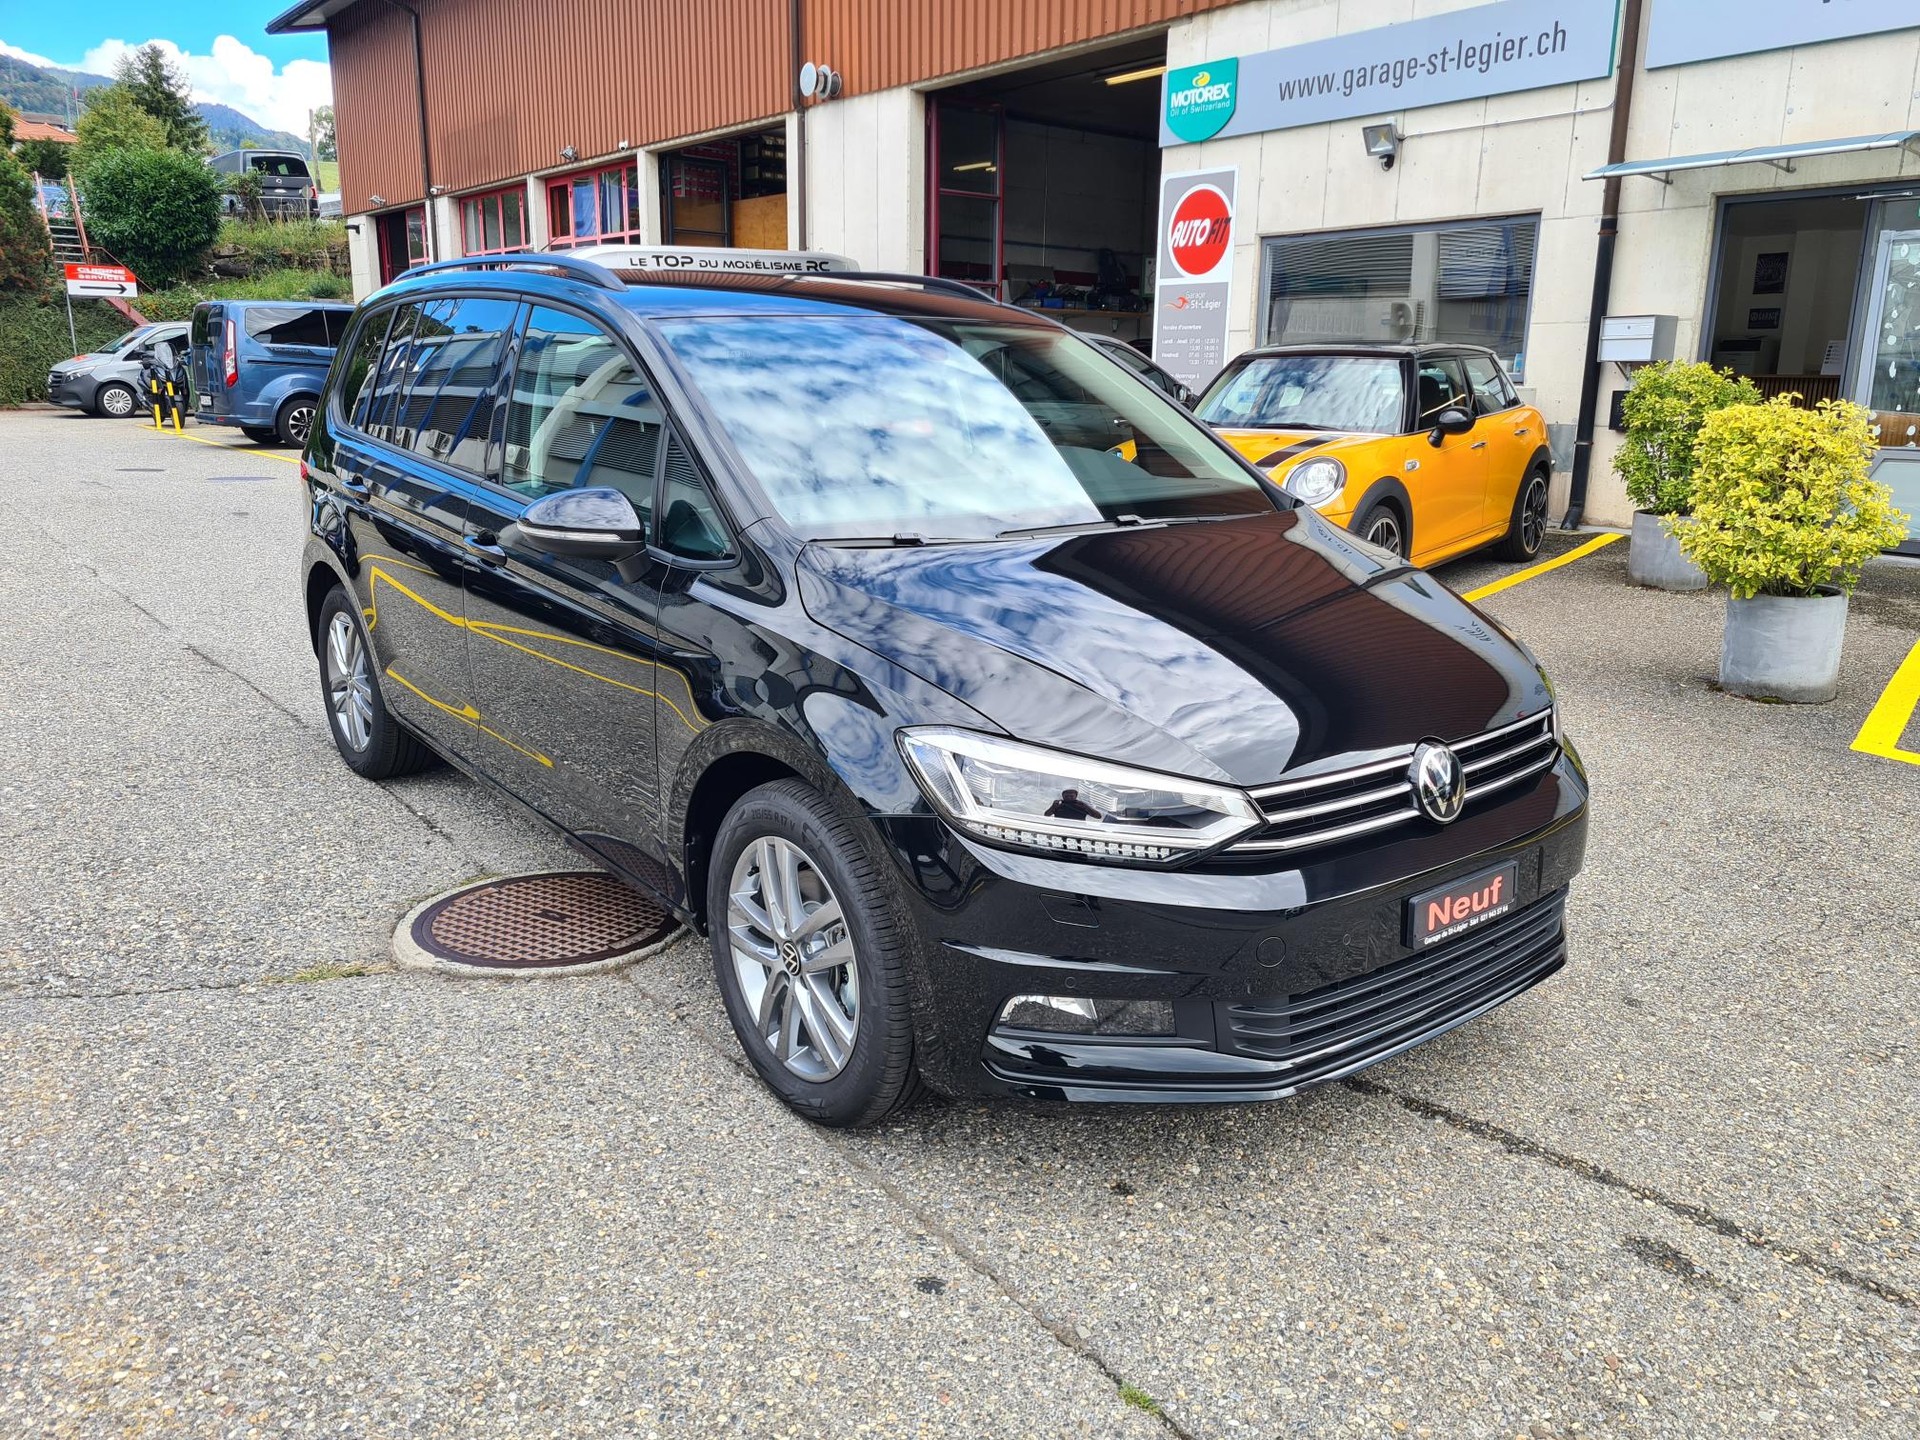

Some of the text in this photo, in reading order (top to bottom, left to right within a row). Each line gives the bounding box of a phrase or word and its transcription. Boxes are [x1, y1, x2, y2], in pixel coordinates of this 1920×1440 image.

[1278, 21, 1567, 101] www.garage-st-legier.ch
[1170, 82, 1231, 109] MOTOREX
[1170, 99, 1231, 117] Oil of Switzerland
[629, 254, 831, 272] LE TOP DU MODÉLISME RC
[1428, 876, 1503, 931] Neuf
